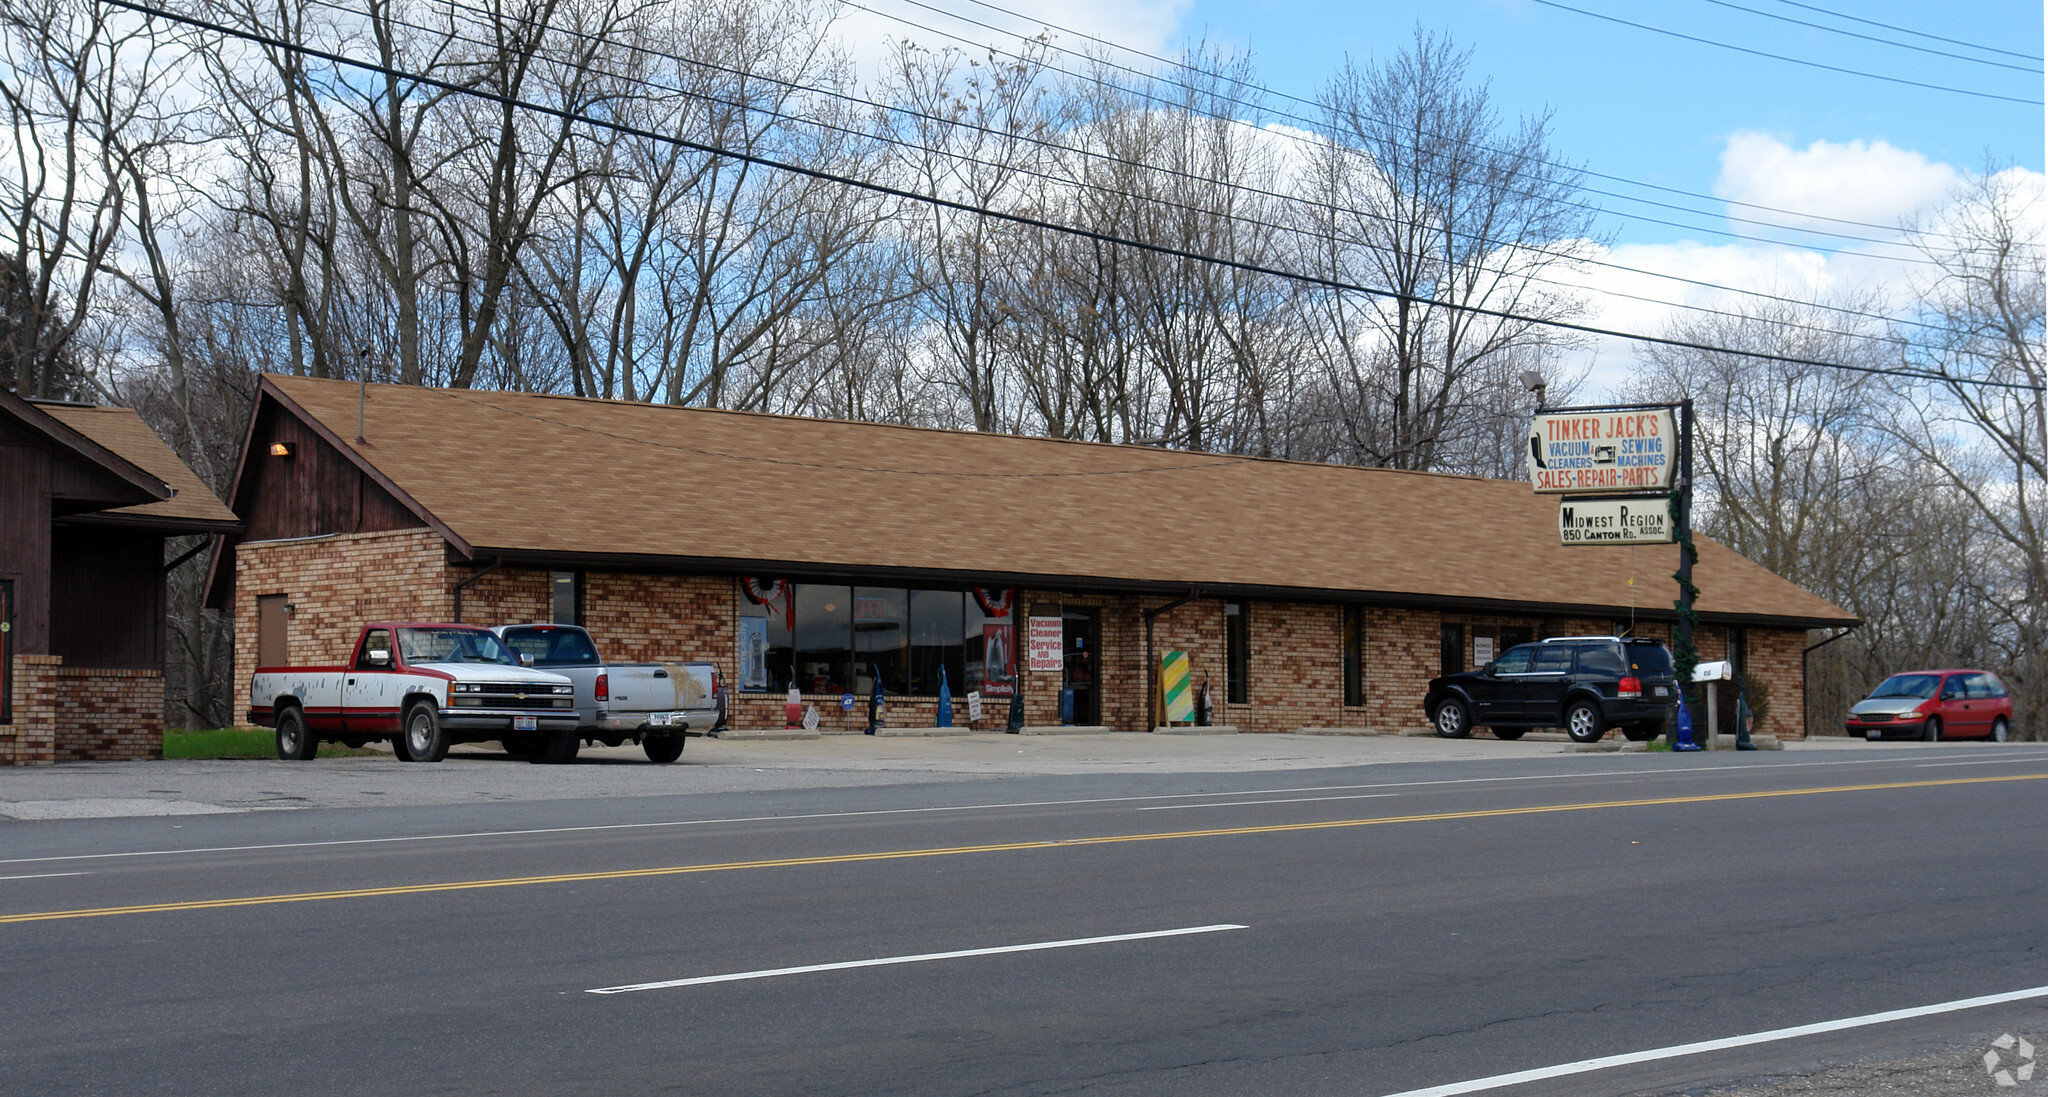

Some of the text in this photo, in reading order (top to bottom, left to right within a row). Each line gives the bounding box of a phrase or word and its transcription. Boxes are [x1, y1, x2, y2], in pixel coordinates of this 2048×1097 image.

[1547, 414, 1659, 441] TINKER JACK'S
[1549, 441, 1590, 457] VACUUM
[1621, 437, 1662, 454] SEWING
[1547, 456, 1593, 470] CLEANERS
[1617, 454, 1666, 467] MACHINES
[1563, 529, 1581, 540] 850
[1584, 528, 1621, 540] CANTON
[853, 599, 885, 619] OPEN
[1030, 618, 1062, 627] Vacuum
[1030, 629, 1062, 638] Cleaner
[1030, 639, 1062, 650] Service
[1030, 657, 1063, 670] Repairs
[985, 684, 1014, 694] Simplicity
